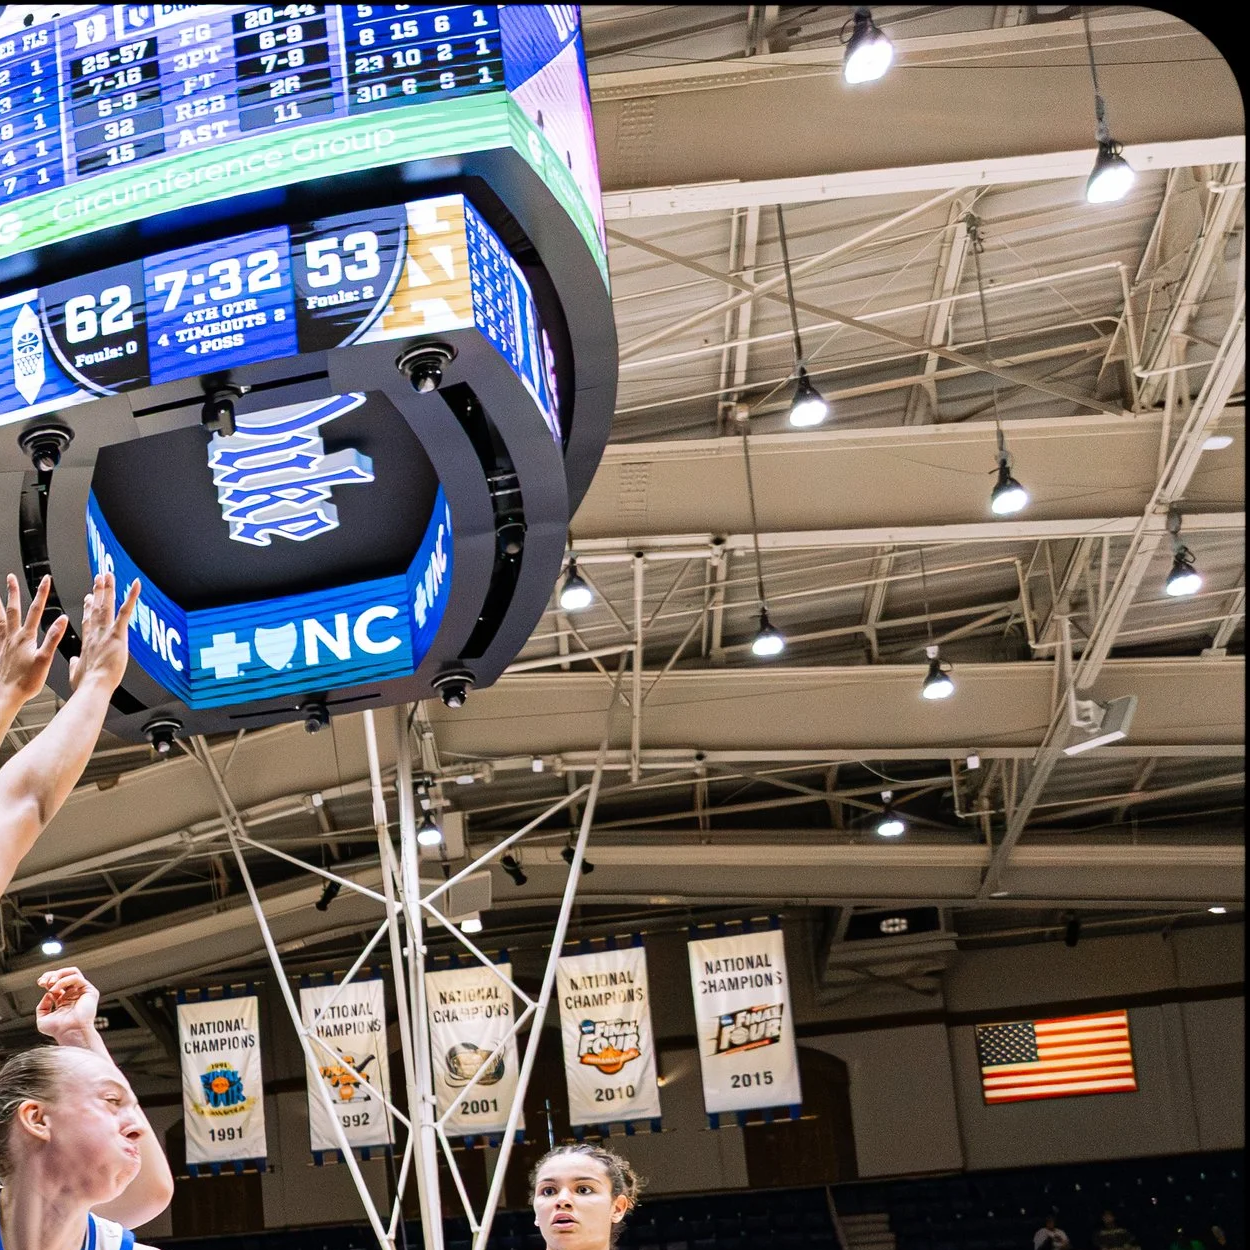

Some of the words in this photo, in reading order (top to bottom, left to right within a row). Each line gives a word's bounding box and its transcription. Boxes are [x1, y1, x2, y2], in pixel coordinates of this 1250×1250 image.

[244, 5, 317, 30] 20-44
[359, 28, 375, 46] 8
[390, 20, 419, 40] 15
[434, 15, 450, 33] 6
[472, 9, 488, 27] 1
[22, 29, 48, 52] FLS
[179, 23, 212, 47] FG
[259, 25, 303, 50] 6-9
[31, 60, 43, 76] 1
[82, 41, 148, 75] 25-57
[173, 45, 222, 72] 3PT
[260, 48, 305, 74] 7-9
[355, 55, 384, 73] 23
[392, 48, 421, 68] 10
[436, 44, 453, 61] 2
[475, 38, 491, 56] 1
[89, 67, 142, 96] 7-16
[183, 72, 216, 95] FT
[270, 75, 301, 98] 26
[357, 83, 387, 103] 30
[478, 66, 494, 84] 1
[0, 96, 12, 114] 3
[32, 86, 45, 103] 1
[98, 92, 137, 117] 5-9
[175, 95, 225, 122] REB
[273, 101, 302, 123] 11
[33, 113, 46, 130] 1
[104, 118, 134, 141] 32
[177, 120, 229, 148] AST
[1, 150, 16, 166] 4
[35, 140, 48, 157] 1
[107, 143, 135, 166] 15
[3, 176, 17, 195] 7
[37, 167, 50, 185] 1
[52, 147, 283, 223] Circumference
[291, 126, 397, 162] Group
[305, 230, 380, 288] 53
[154, 249, 282, 313] 7:32
[307, 289, 359, 310] Fouls:
[362, 285, 375, 300] 2
[64, 284, 134, 344] 62
[182, 307, 218, 325] 4TH
[221, 299, 258, 317] QTR
[158, 334, 170, 347] 4
[175, 314, 266, 343] TIMEOUTS
[273, 309, 285, 322] 2
[75, 347, 123, 368] Fouls:
[126, 341, 137, 355] 0
[200, 333, 245, 354] POSS
[150, 608, 184, 671] NC
[303, 605, 402, 666] NC
[705, 953, 772, 973] NATIONAL
[570, 971, 634, 991] NATIONAL
[699, 971, 782, 995] CHAMPIONS
[439, 986, 500, 1005] NATIONAL
[564, 989, 643, 1010] CHAMPIONS
[314, 1002, 373, 1020] NTIONAL
[190, 1018, 248, 1037] NATIONAL
[316, 1019, 381, 1038] HAMPIONS
[184, 1033, 255, 1055] CHAMPIONS
[731, 1071, 773, 1089] 2015
[595, 1084, 635, 1102] 2010
[461, 1099, 498, 1115] 2001
[341, 1113, 370, 1128] 992
[209, 1126, 243, 1142] 1991
